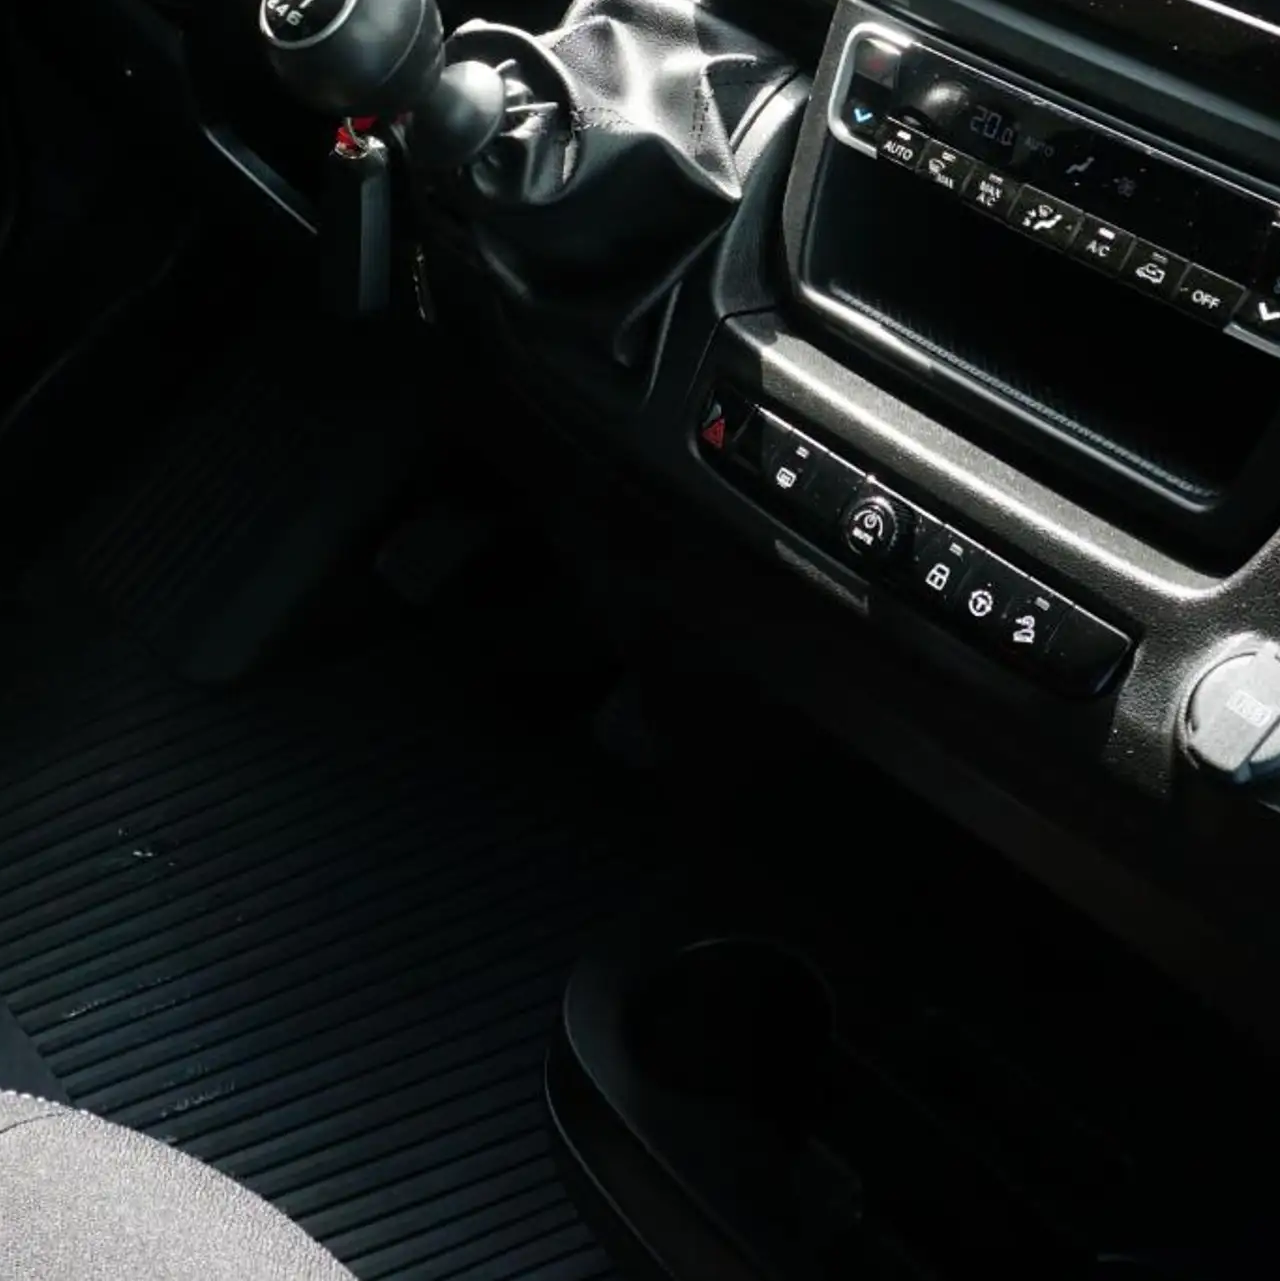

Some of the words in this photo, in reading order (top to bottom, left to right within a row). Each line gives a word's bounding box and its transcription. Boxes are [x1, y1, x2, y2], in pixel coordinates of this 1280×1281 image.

[883, 140, 913, 161] AUTO
[1024, 136, 1054, 157] AUTO
[1191, 289, 1221, 309] OFF
